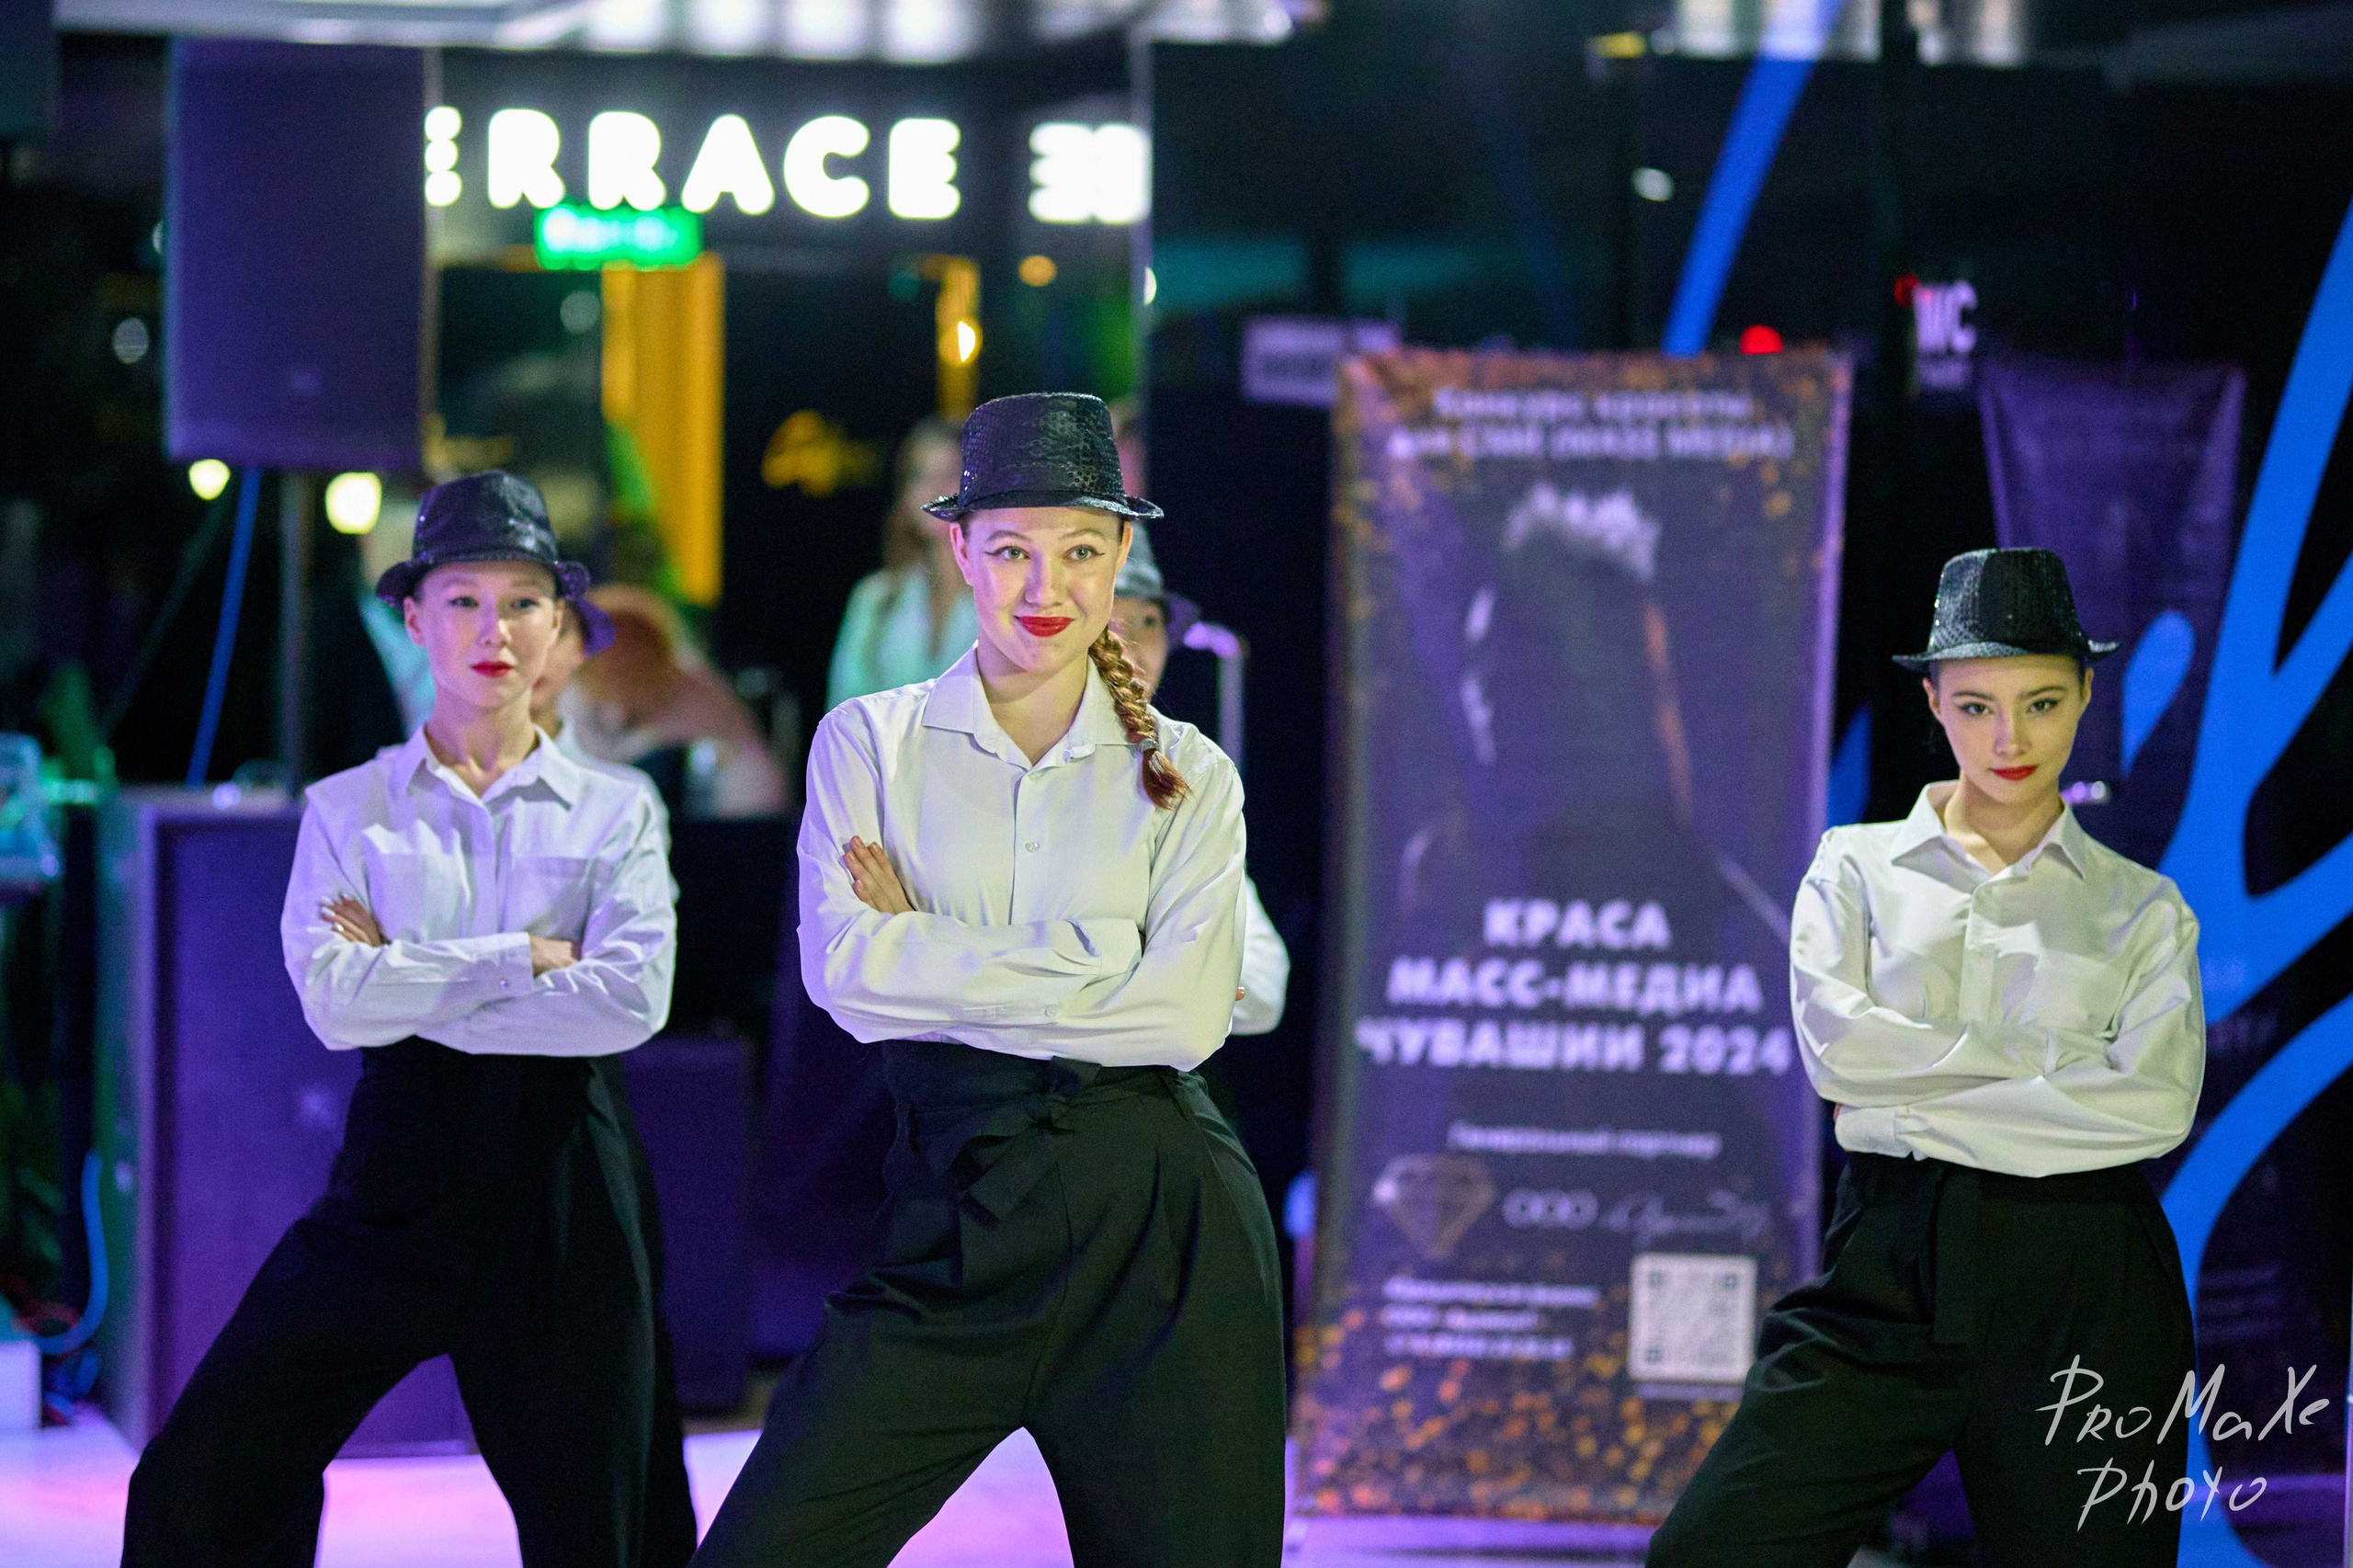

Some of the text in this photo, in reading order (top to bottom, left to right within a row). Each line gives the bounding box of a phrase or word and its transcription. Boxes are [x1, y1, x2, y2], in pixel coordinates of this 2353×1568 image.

[1914, 279, 1977, 352] WC
[1483, 898, 1672, 949] КРАСА
[1386, 957, 1762, 1016] МАСС-МЕДИА
[1355, 1016, 1791, 1075] ЧУВАШИИ 2024
